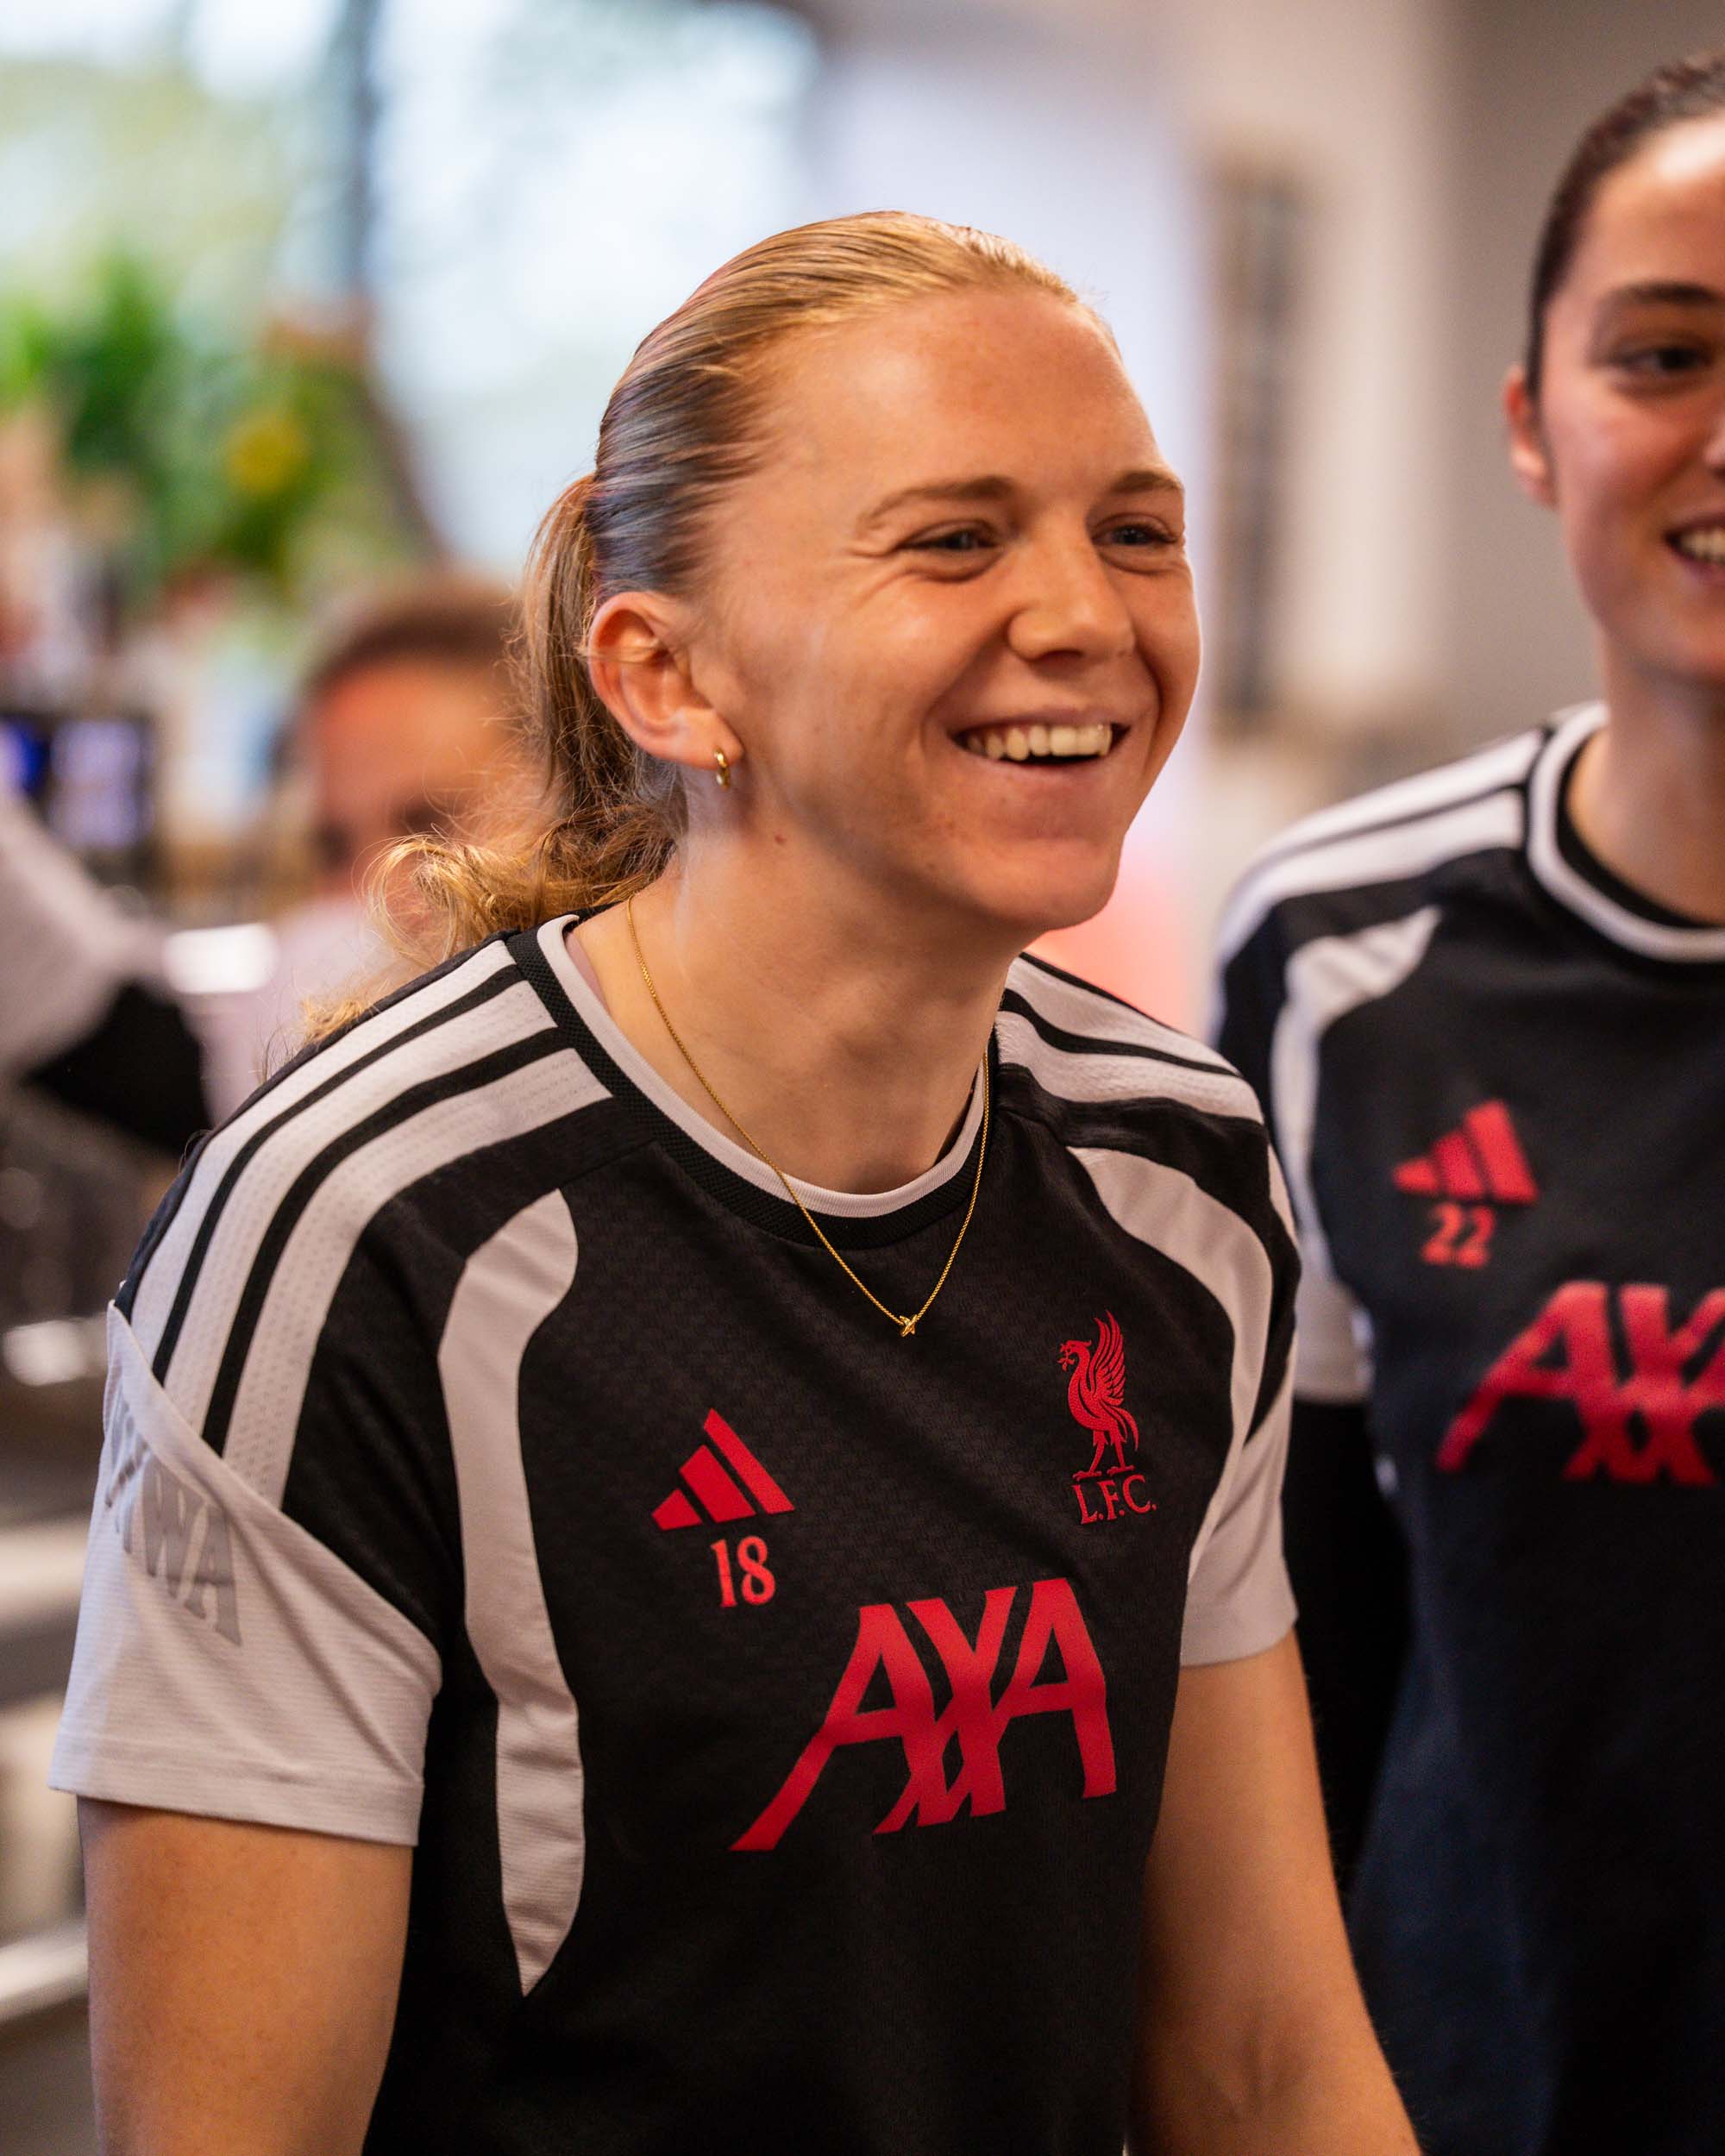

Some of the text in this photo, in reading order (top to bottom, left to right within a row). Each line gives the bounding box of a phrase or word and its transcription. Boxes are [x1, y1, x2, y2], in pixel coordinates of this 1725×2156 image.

[1421, 1202, 1496, 1269] 22
[1071, 1474, 1157, 1525] L.F.C.
[710, 1535, 776, 1608] 18
[729, 1577, 1117, 1852] AXA
